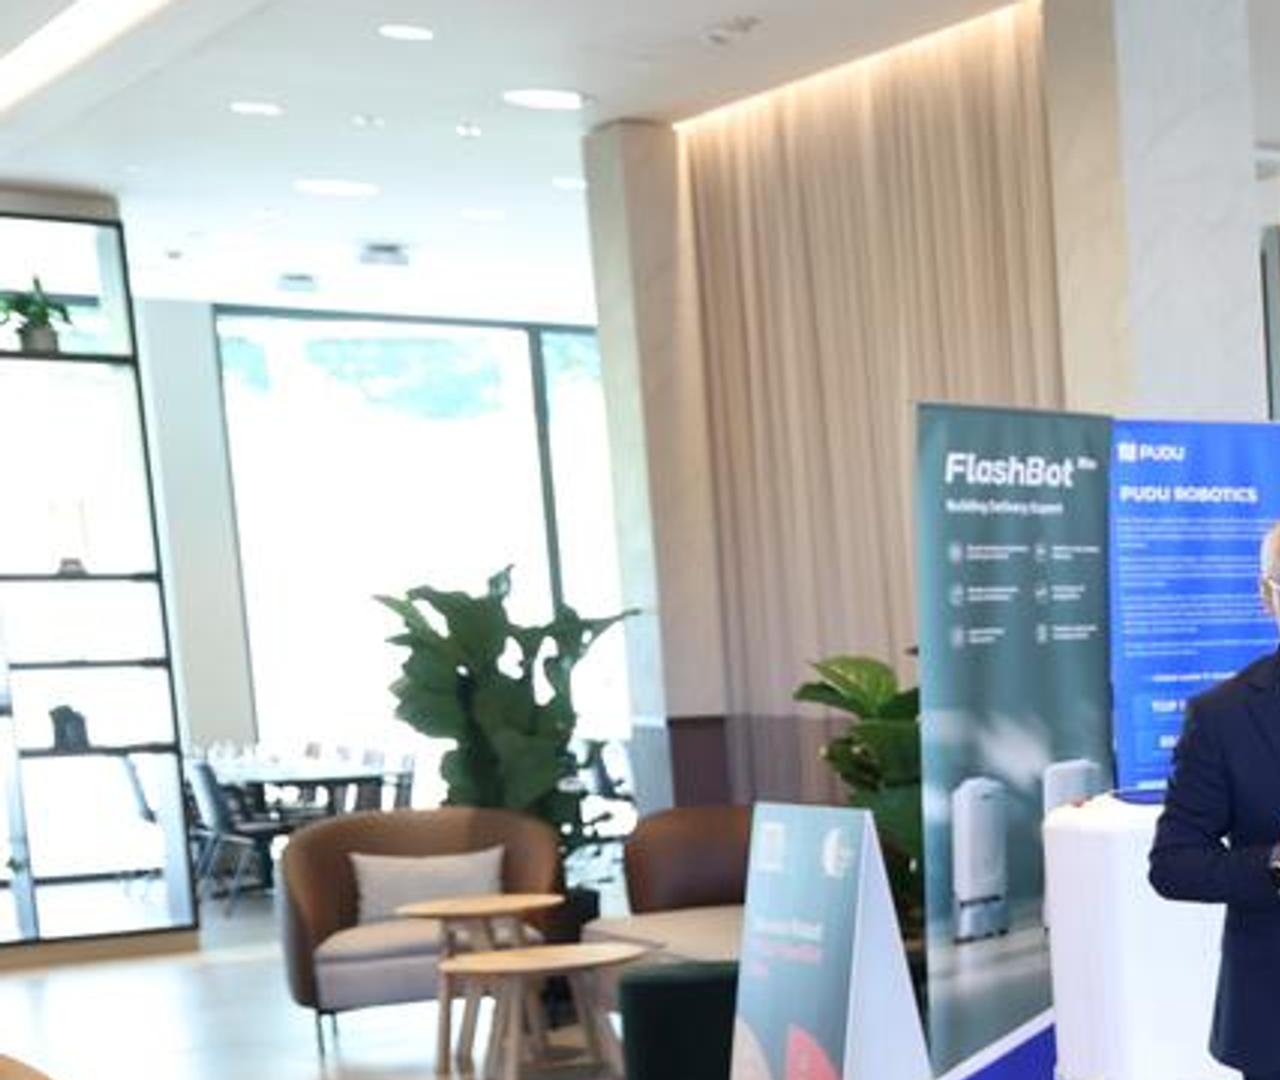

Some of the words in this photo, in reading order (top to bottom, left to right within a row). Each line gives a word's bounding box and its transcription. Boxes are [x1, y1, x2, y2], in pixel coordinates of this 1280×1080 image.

[1139, 442, 1186, 463] PUDU
[945, 452, 1075, 488] FlashBot
[1119, 485, 1172, 503] PUDU
[1174, 485, 1259, 504] ROBOTICS
